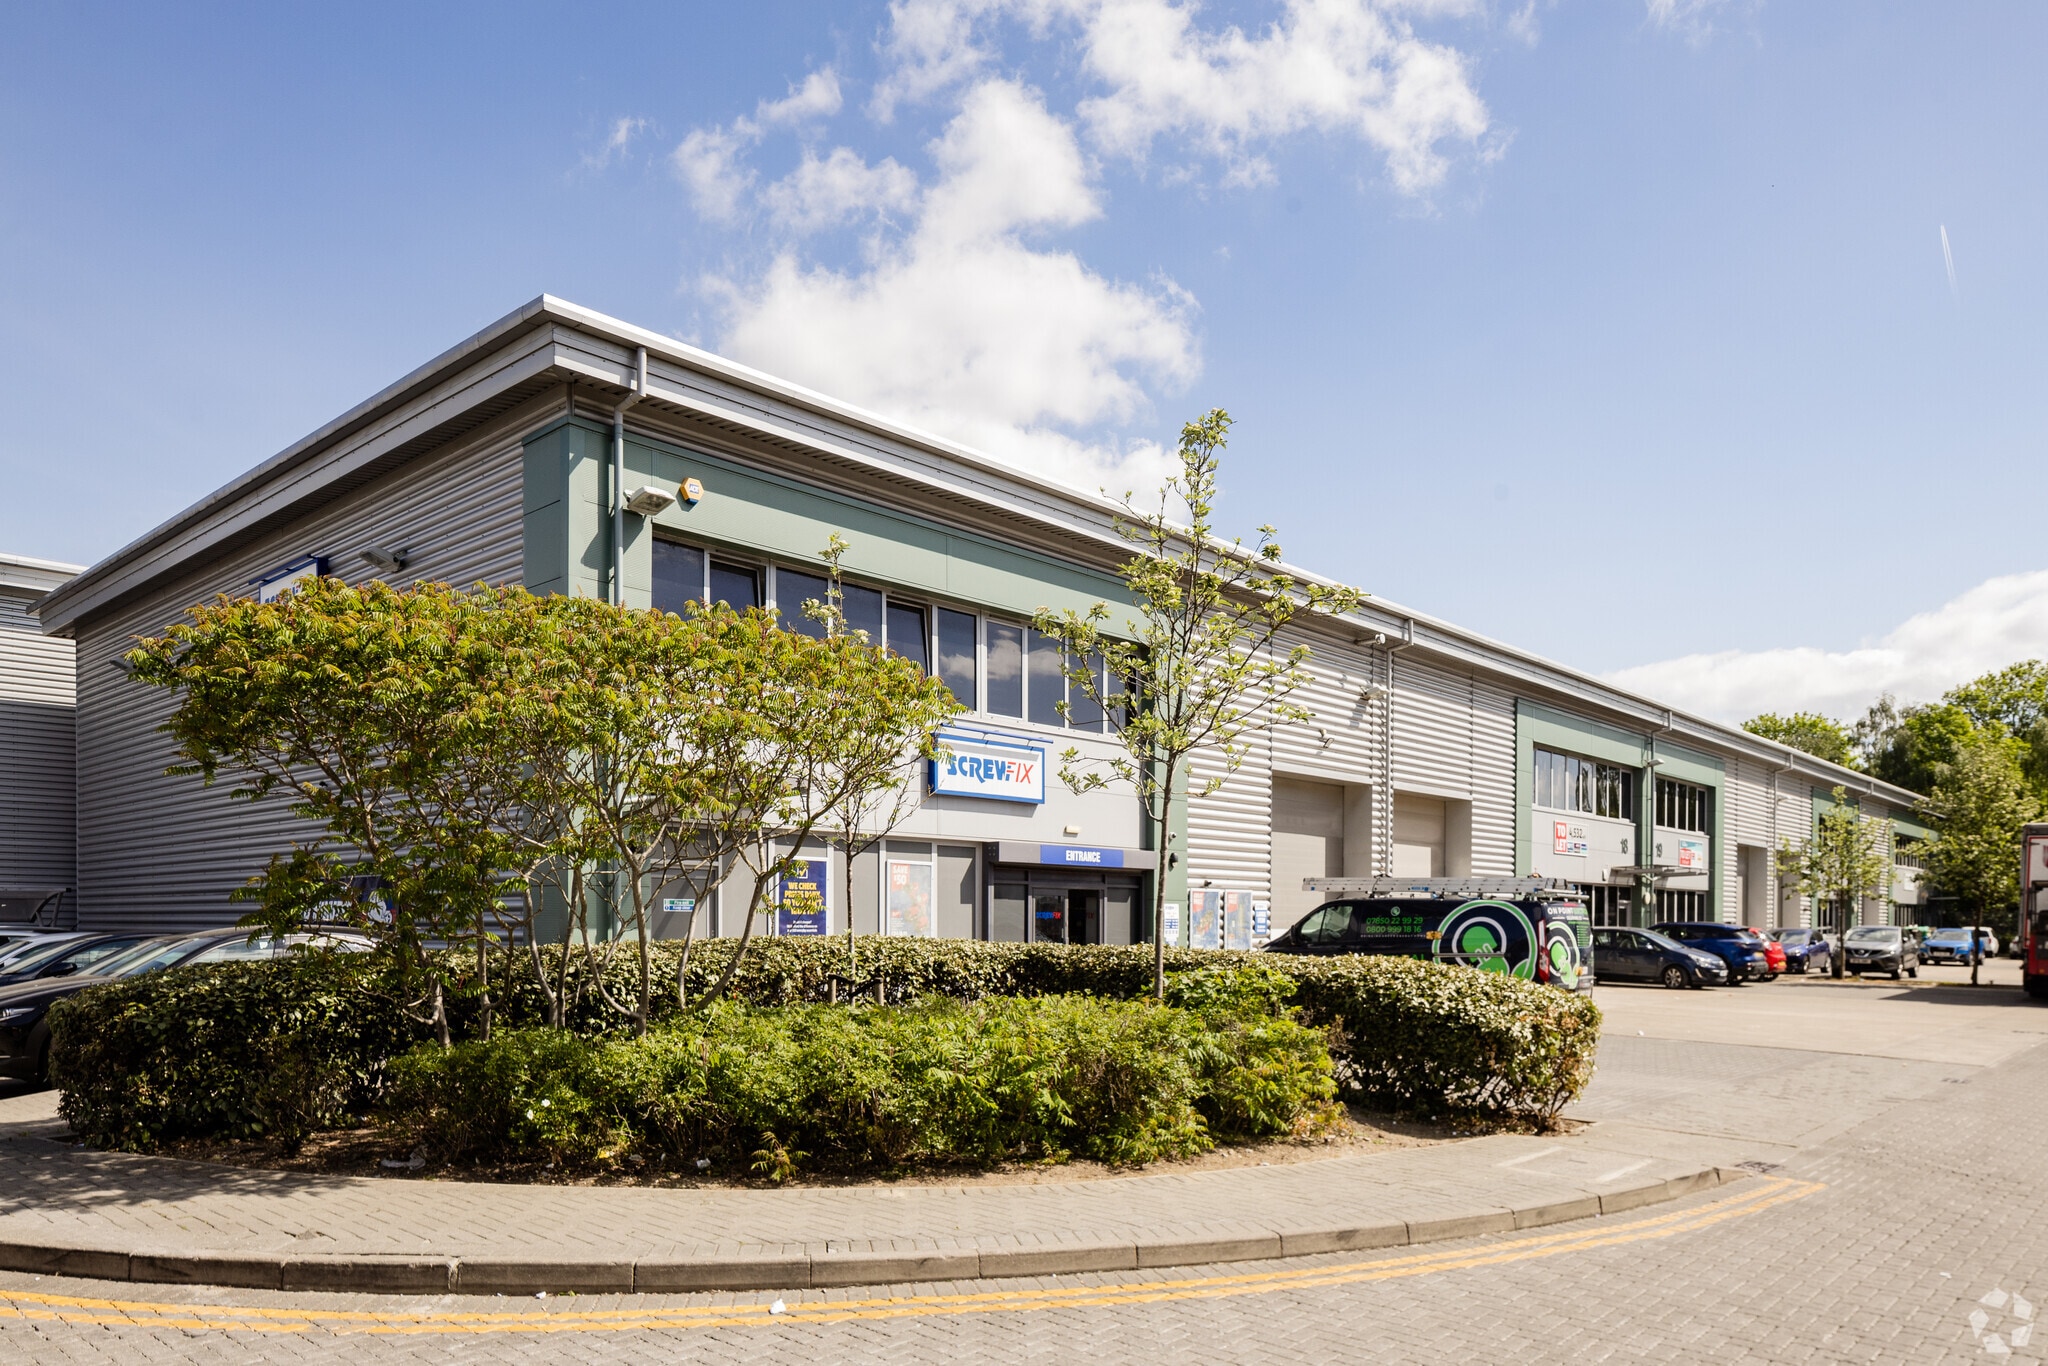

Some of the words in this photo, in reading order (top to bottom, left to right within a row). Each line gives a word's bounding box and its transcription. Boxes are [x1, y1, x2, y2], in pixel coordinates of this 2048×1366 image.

[947, 755, 1034, 784] SCREWFIX
[1556, 824, 1566, 837] TO
[1556, 839, 1566, 852] LET
[1620, 838, 1629, 855] 18
[1655, 843, 1663, 858] 19
[1065, 850, 1101, 863] ENTRANCE
[892, 865, 909, 874] SAVE
[787, 882, 798, 890] WE
[1547, 907, 1558, 915] ON
[1366, 917, 1390, 925] 07850
[1391, 917, 1400, 925] 22
[1402, 917, 1412, 925] 99
[1413, 916, 1424, 925] 29
